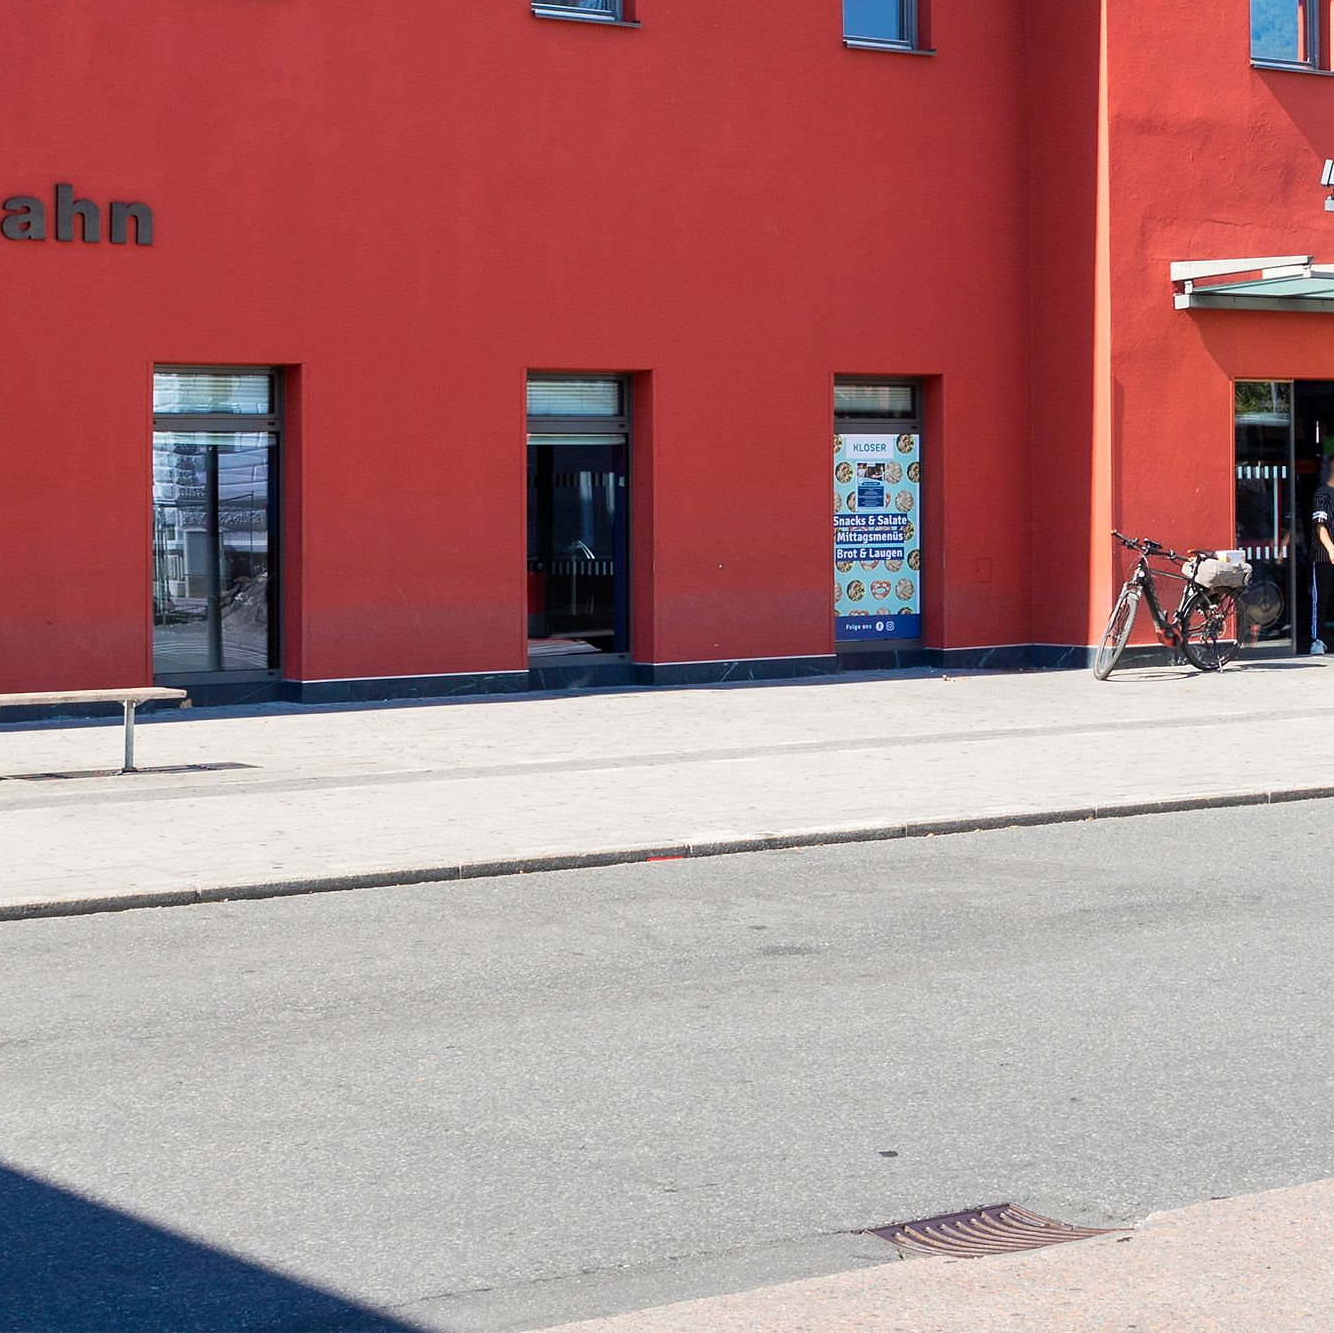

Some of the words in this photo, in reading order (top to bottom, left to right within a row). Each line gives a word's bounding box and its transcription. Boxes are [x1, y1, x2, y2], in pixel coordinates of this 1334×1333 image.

[853, 443, 887, 452] KLOSER
[833, 515, 866, 526] Snacks
[868, 515, 876, 526] &
[877, 514, 908, 525] Salate
[837, 531, 904, 544] Mittagsmenüs
[836, 548, 858, 559] Brot
[859, 548, 867, 558] &
[869, 548, 903, 560] Laugen
